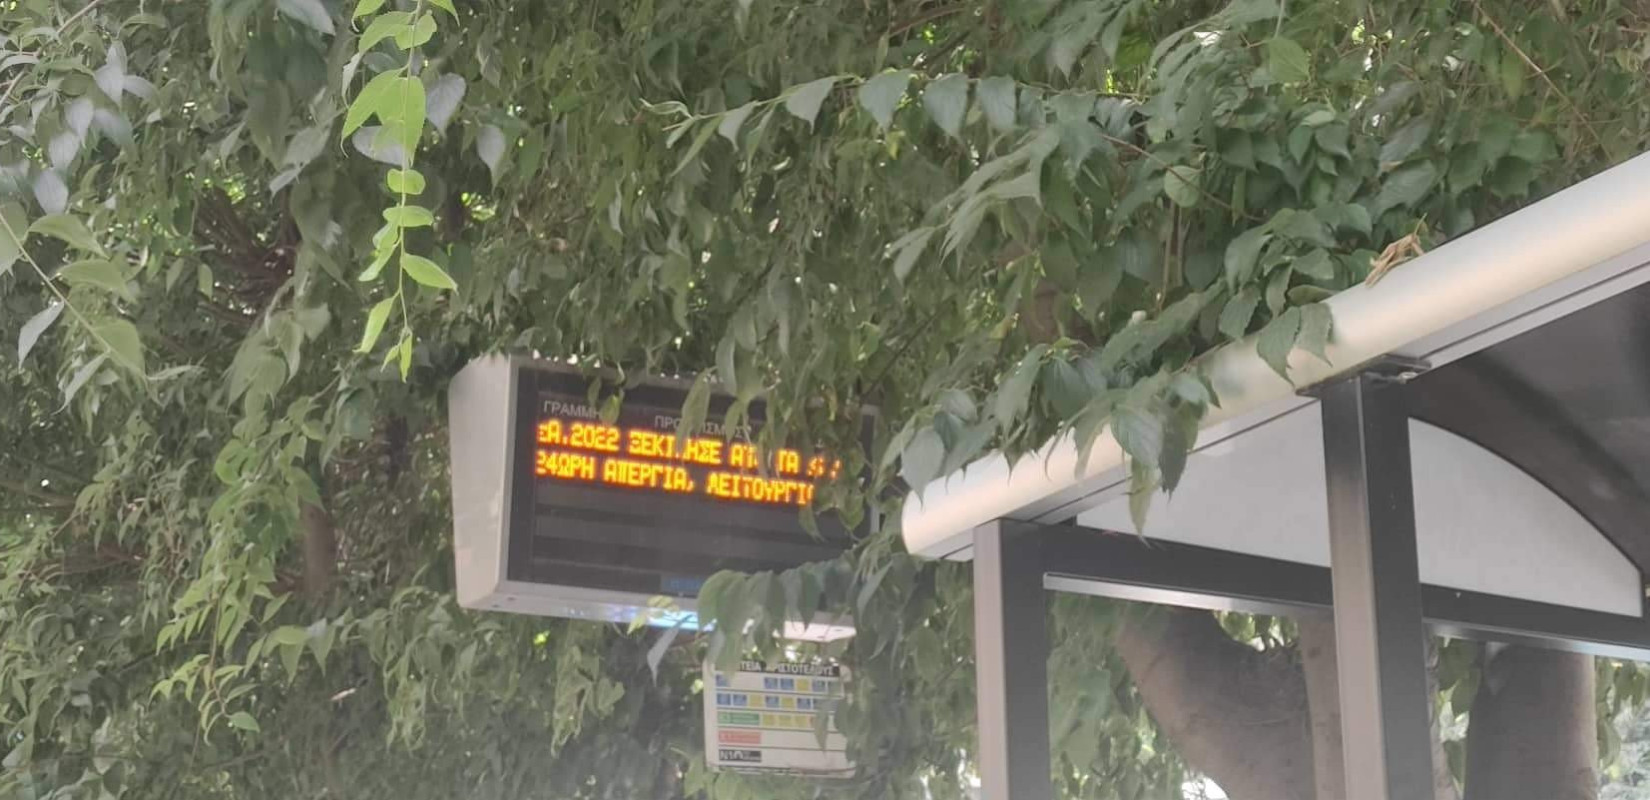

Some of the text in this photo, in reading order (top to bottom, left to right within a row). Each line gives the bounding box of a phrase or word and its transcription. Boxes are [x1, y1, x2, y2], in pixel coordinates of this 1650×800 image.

[629, 430, 723, 464] ΞΕΚΙΗΣΕ
[537, 450, 596, 479] 24ΩΡΗ
[603, 459, 695, 492] ΑΠΕΡΓΙΑ,
